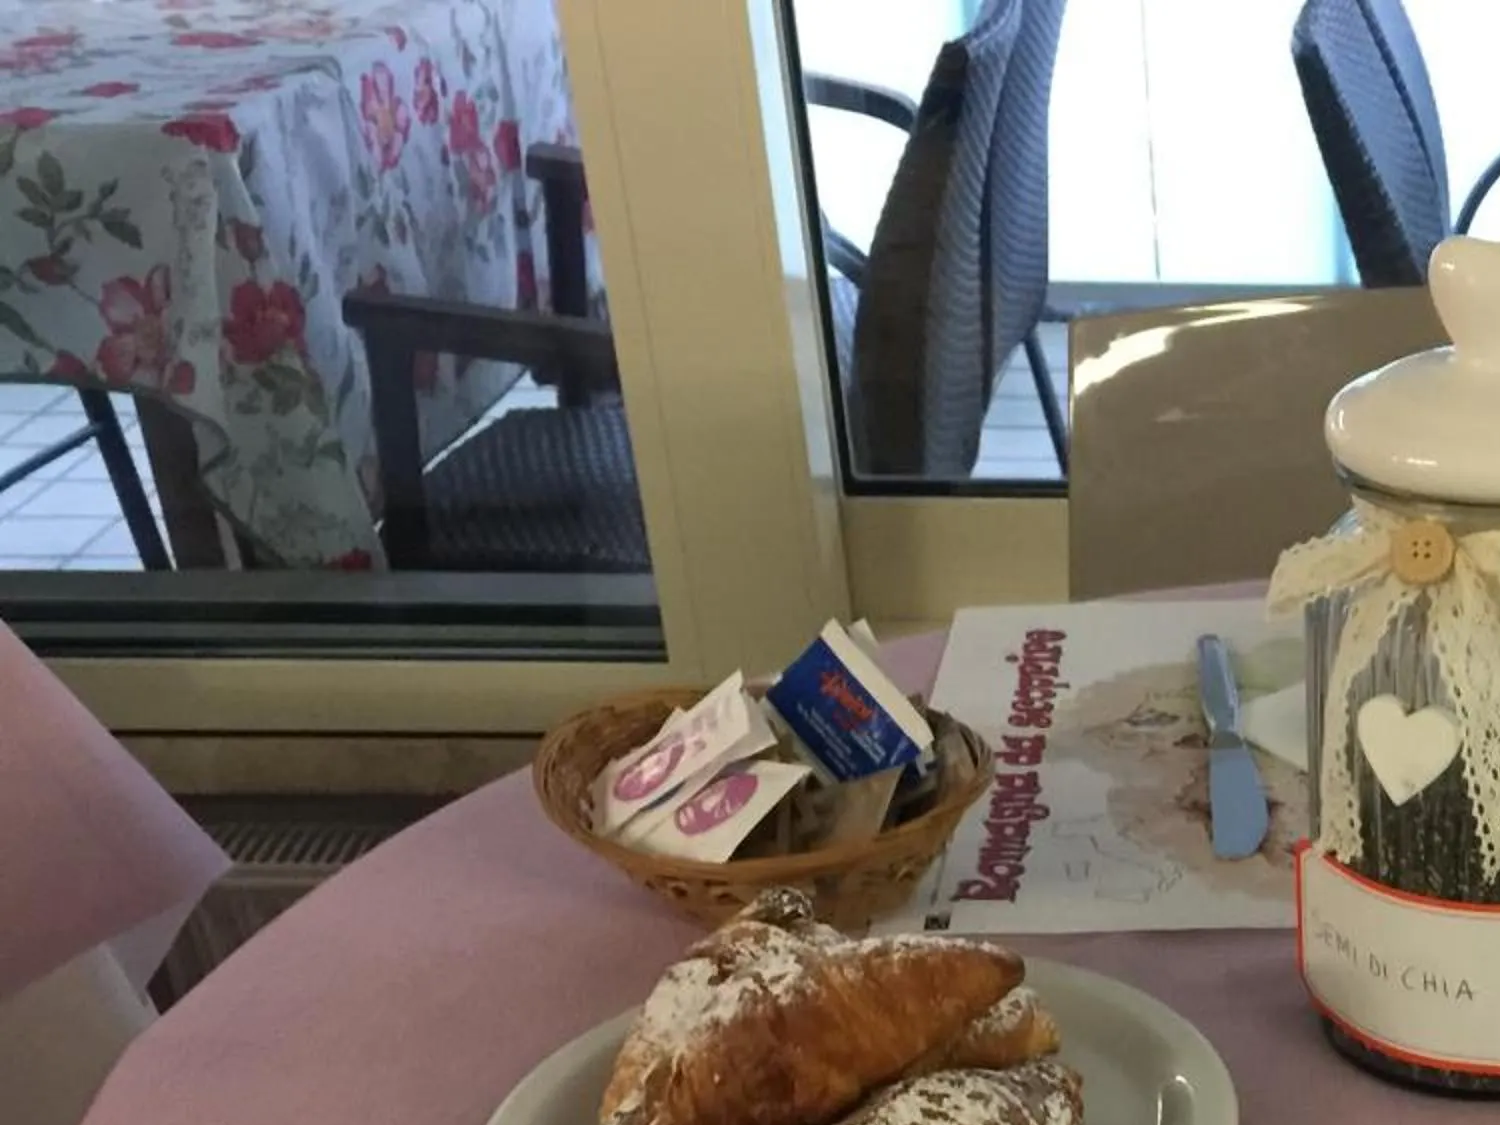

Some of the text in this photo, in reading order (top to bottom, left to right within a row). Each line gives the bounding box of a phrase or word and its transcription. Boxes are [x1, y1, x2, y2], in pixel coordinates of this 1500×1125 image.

[950, 771, 1050, 903] Romagna
[1368, 952, 1388, 979] DI
[1400, 965, 1474, 1001] CHIA
